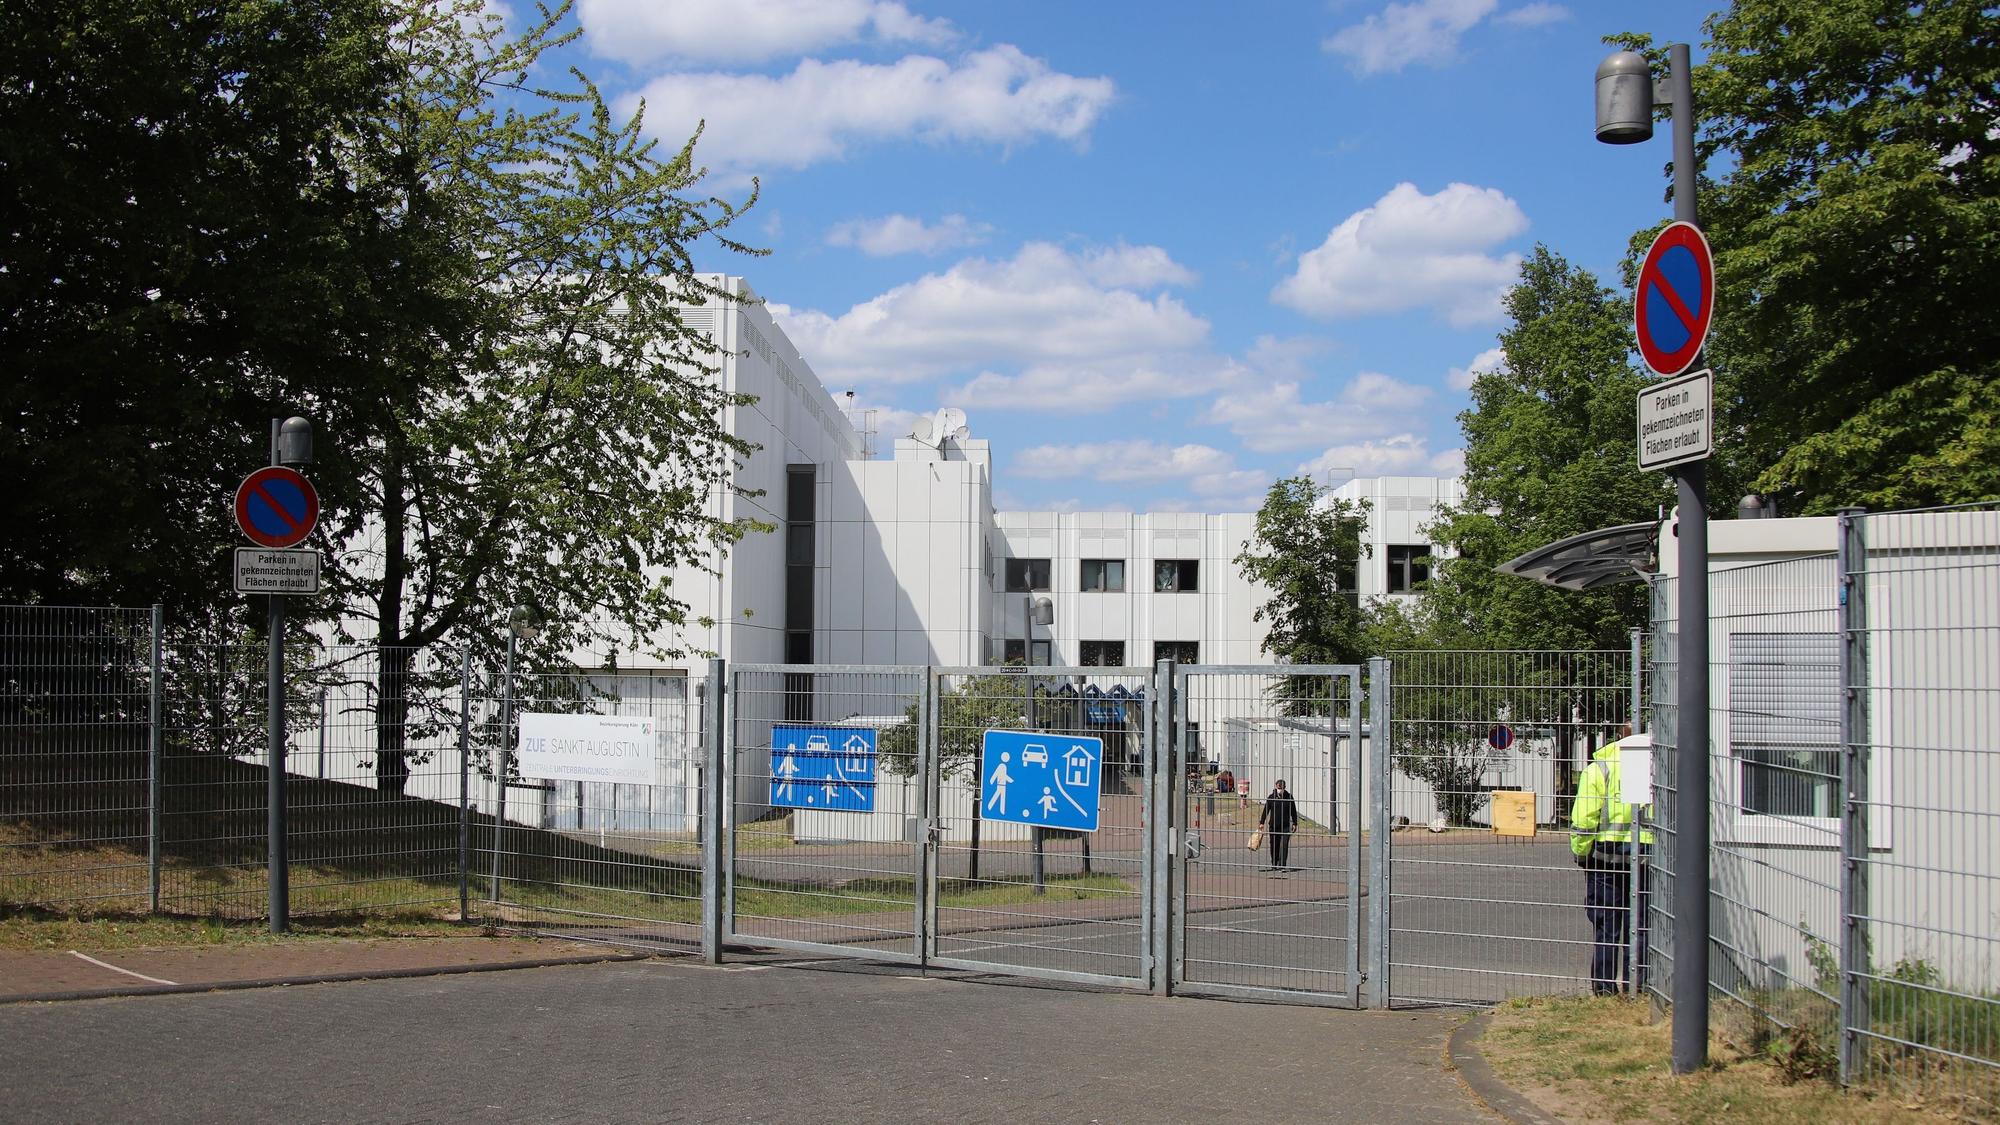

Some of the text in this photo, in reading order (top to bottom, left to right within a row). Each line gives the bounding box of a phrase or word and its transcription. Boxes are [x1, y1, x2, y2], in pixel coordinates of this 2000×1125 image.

[1656, 389, 1689, 411] Parken in
[1642, 408, 1704, 439] gekennzeichneten
[1646, 429, 1700, 455] Flächen erlaubt
[258, 555, 296, 564] Parken in
[240, 566, 314, 576] gekennzeichneten
[245, 577, 308, 588] Flächen erlaubt
[525, 737, 546, 753] ZUE
[551, 738, 585, 755] SANKT
[587, 740, 640, 758] AUGUSTIN
